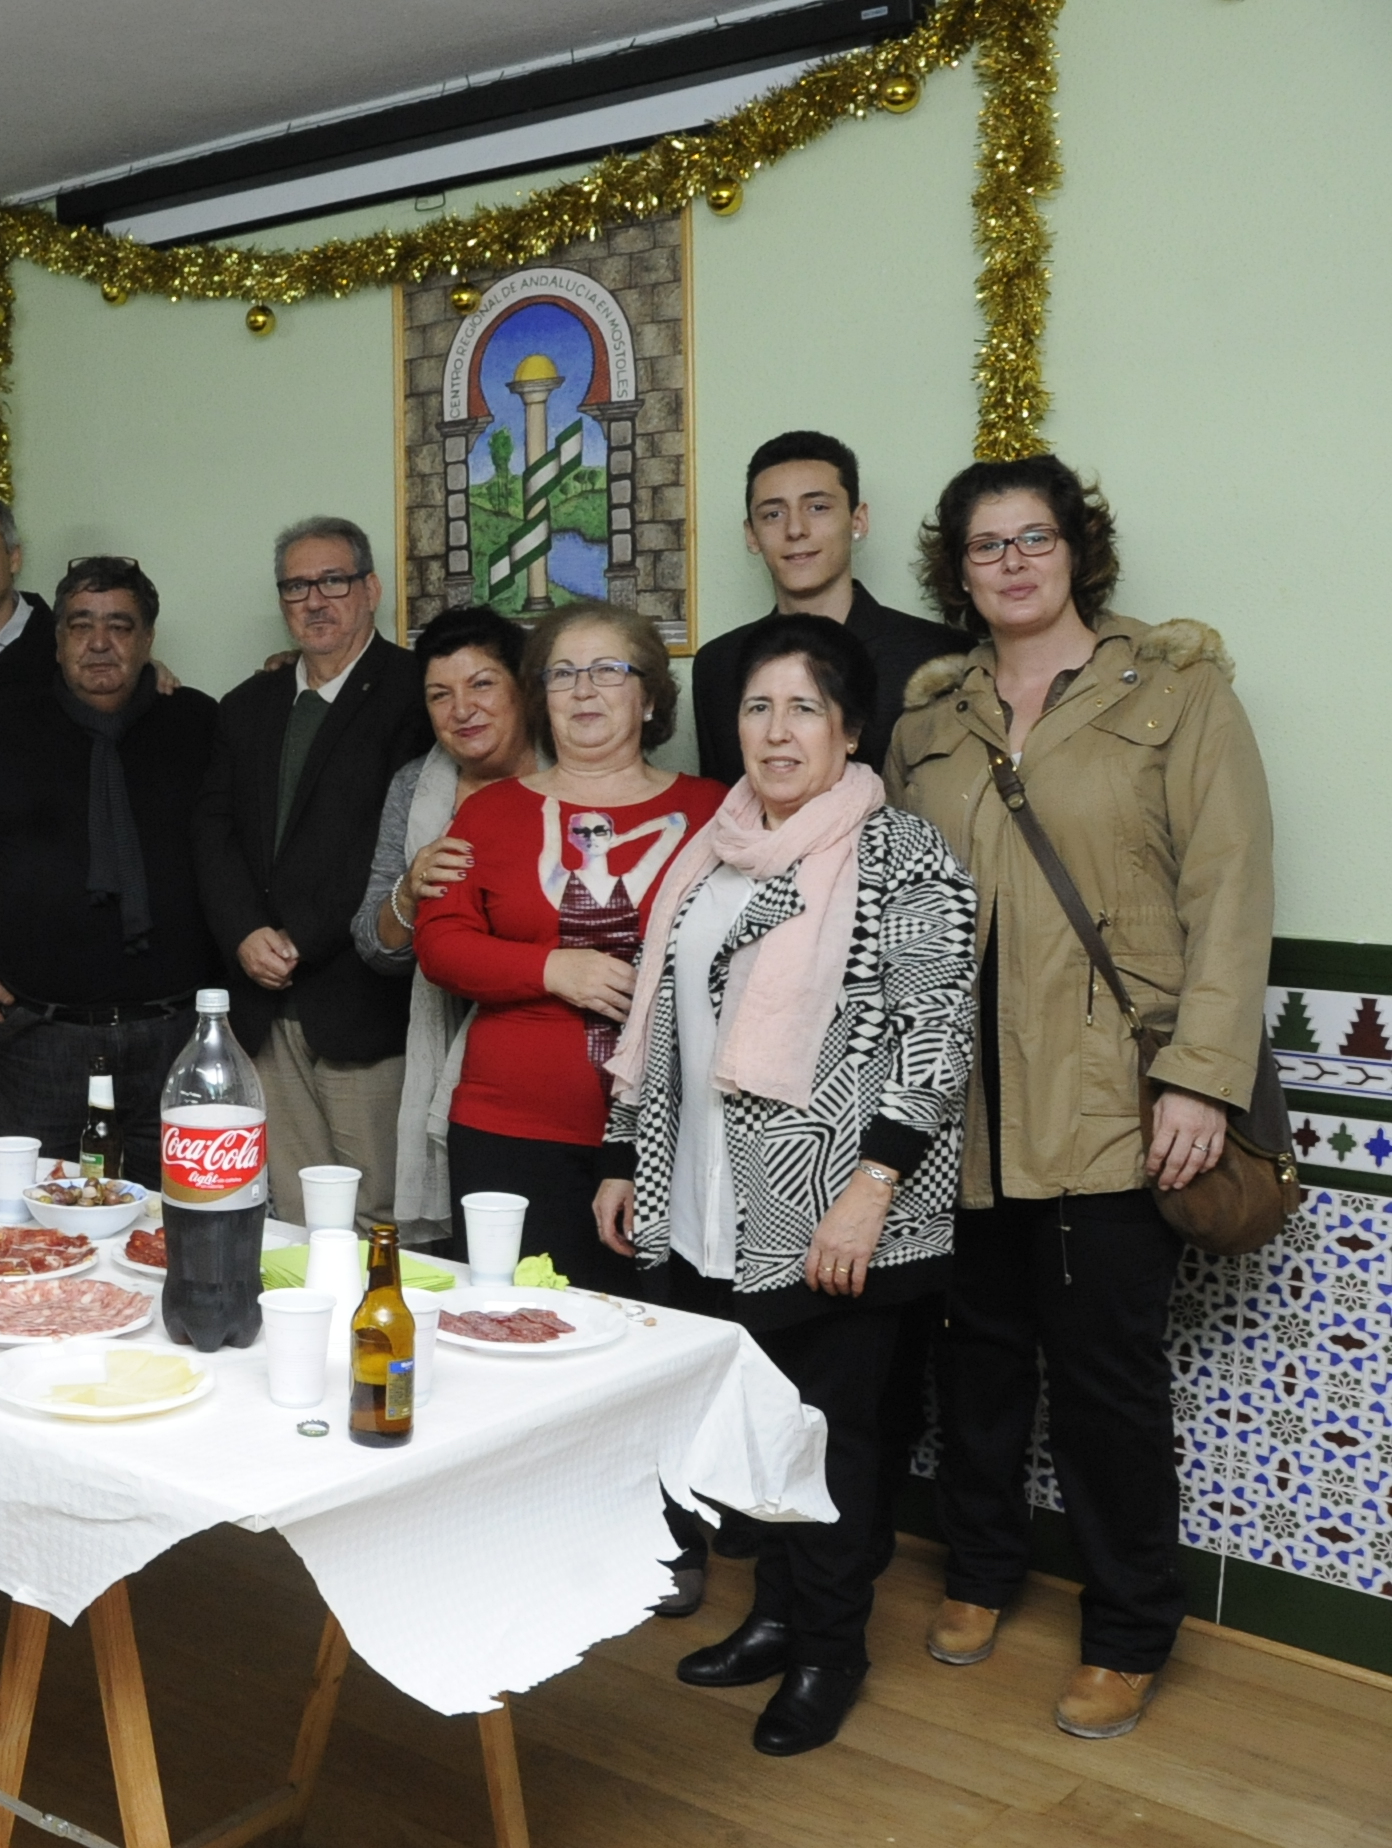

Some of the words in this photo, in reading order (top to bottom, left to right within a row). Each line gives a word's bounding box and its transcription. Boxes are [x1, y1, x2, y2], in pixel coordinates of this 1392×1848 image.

[501, 281, 517, 298] DE
[596, 300, 613, 319] EN
[456, 295, 502, 356] REGIONAL
[450, 358, 464, 419] CENTRO
[163, 1127, 262, 1171] Coca-Cola
[188, 1171, 219, 1187] light
